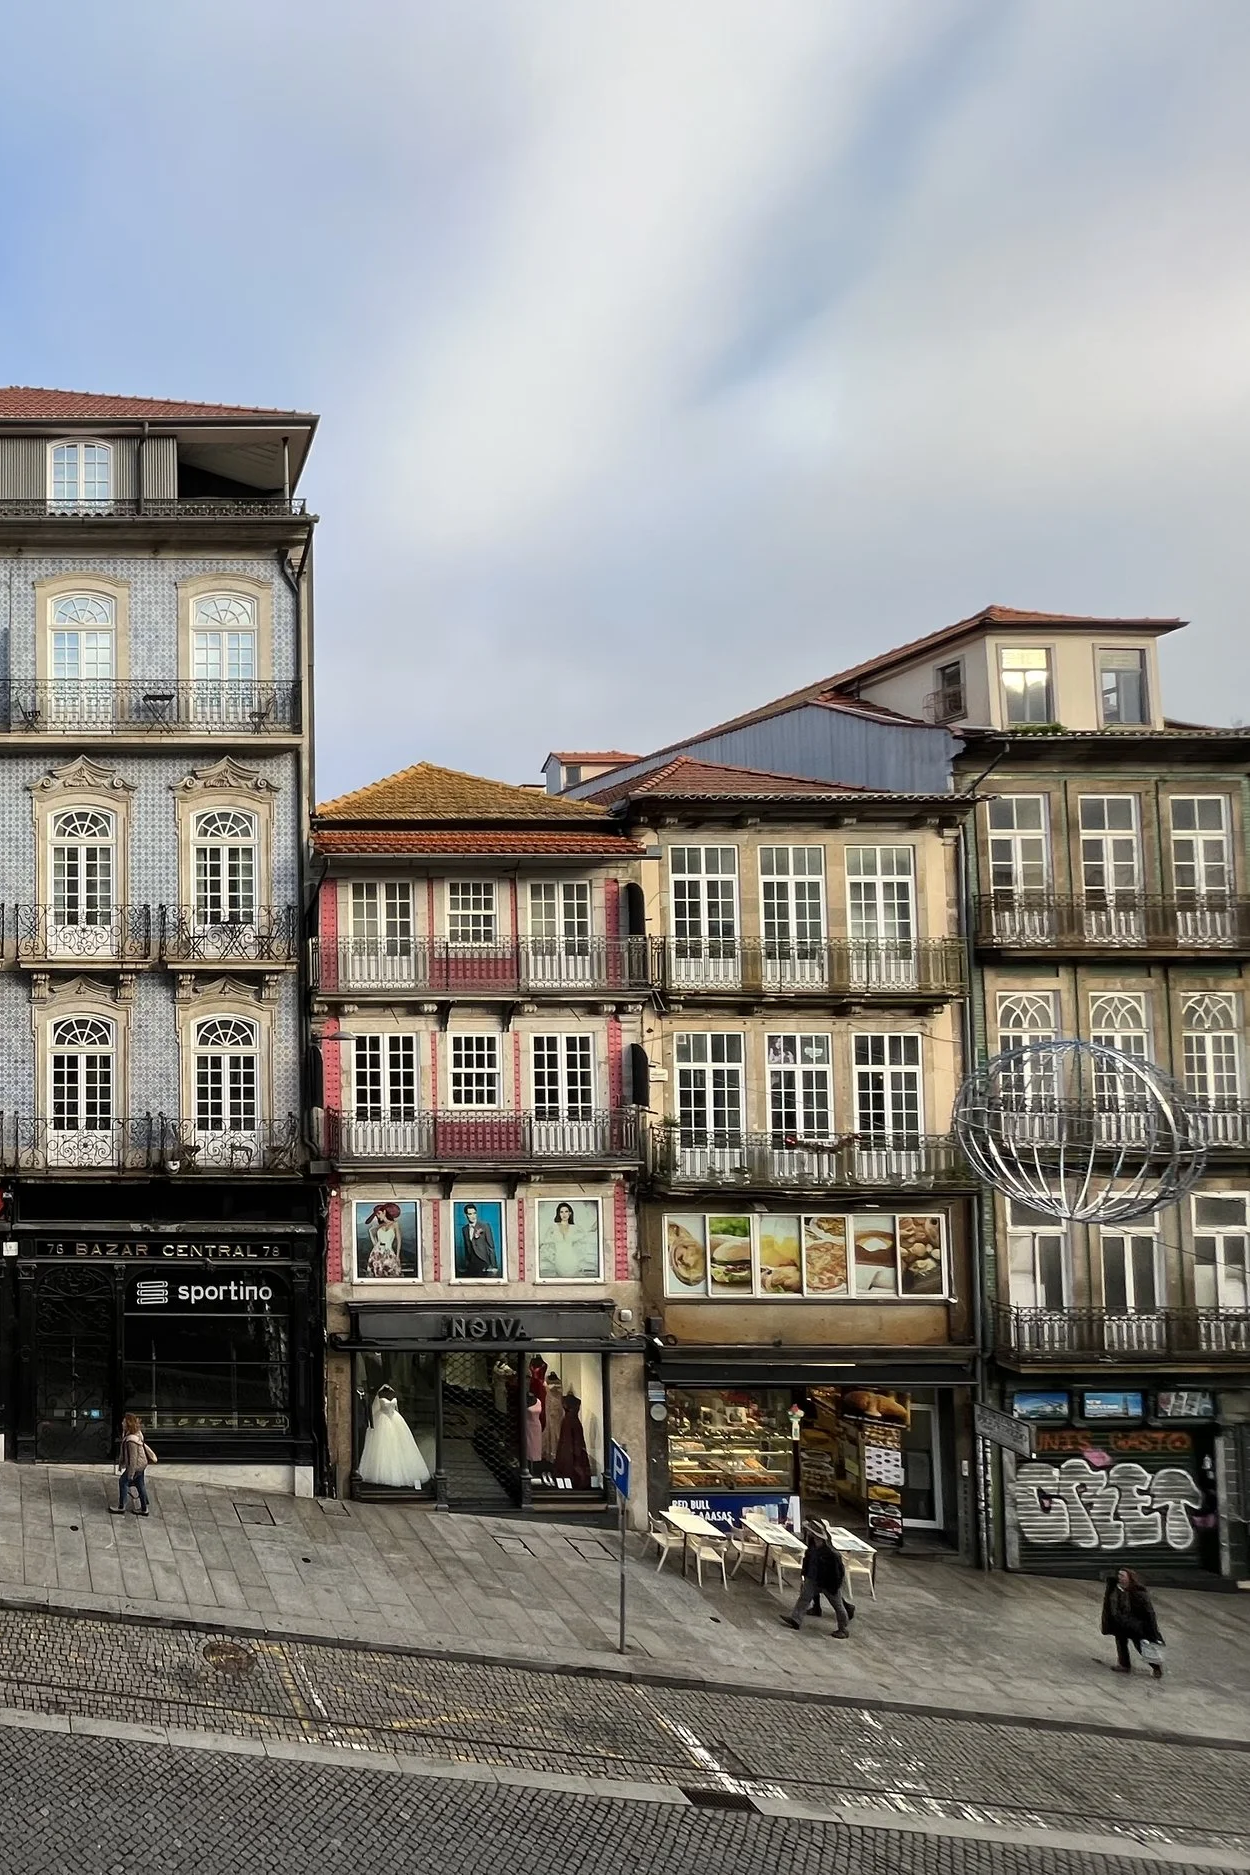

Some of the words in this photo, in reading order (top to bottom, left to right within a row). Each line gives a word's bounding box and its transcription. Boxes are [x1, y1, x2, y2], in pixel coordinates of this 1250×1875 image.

[75, 1243, 149, 1256] BAZAR
[162, 1244, 258, 1258] CENTRAL
[262, 1246, 281, 1257] 78
[177, 1280, 274, 1304] sportino
[452, 1315, 530, 1338] NOIVA
[613, 1446, 625, 1481] P
[690, 1500, 710, 1510] BULL
